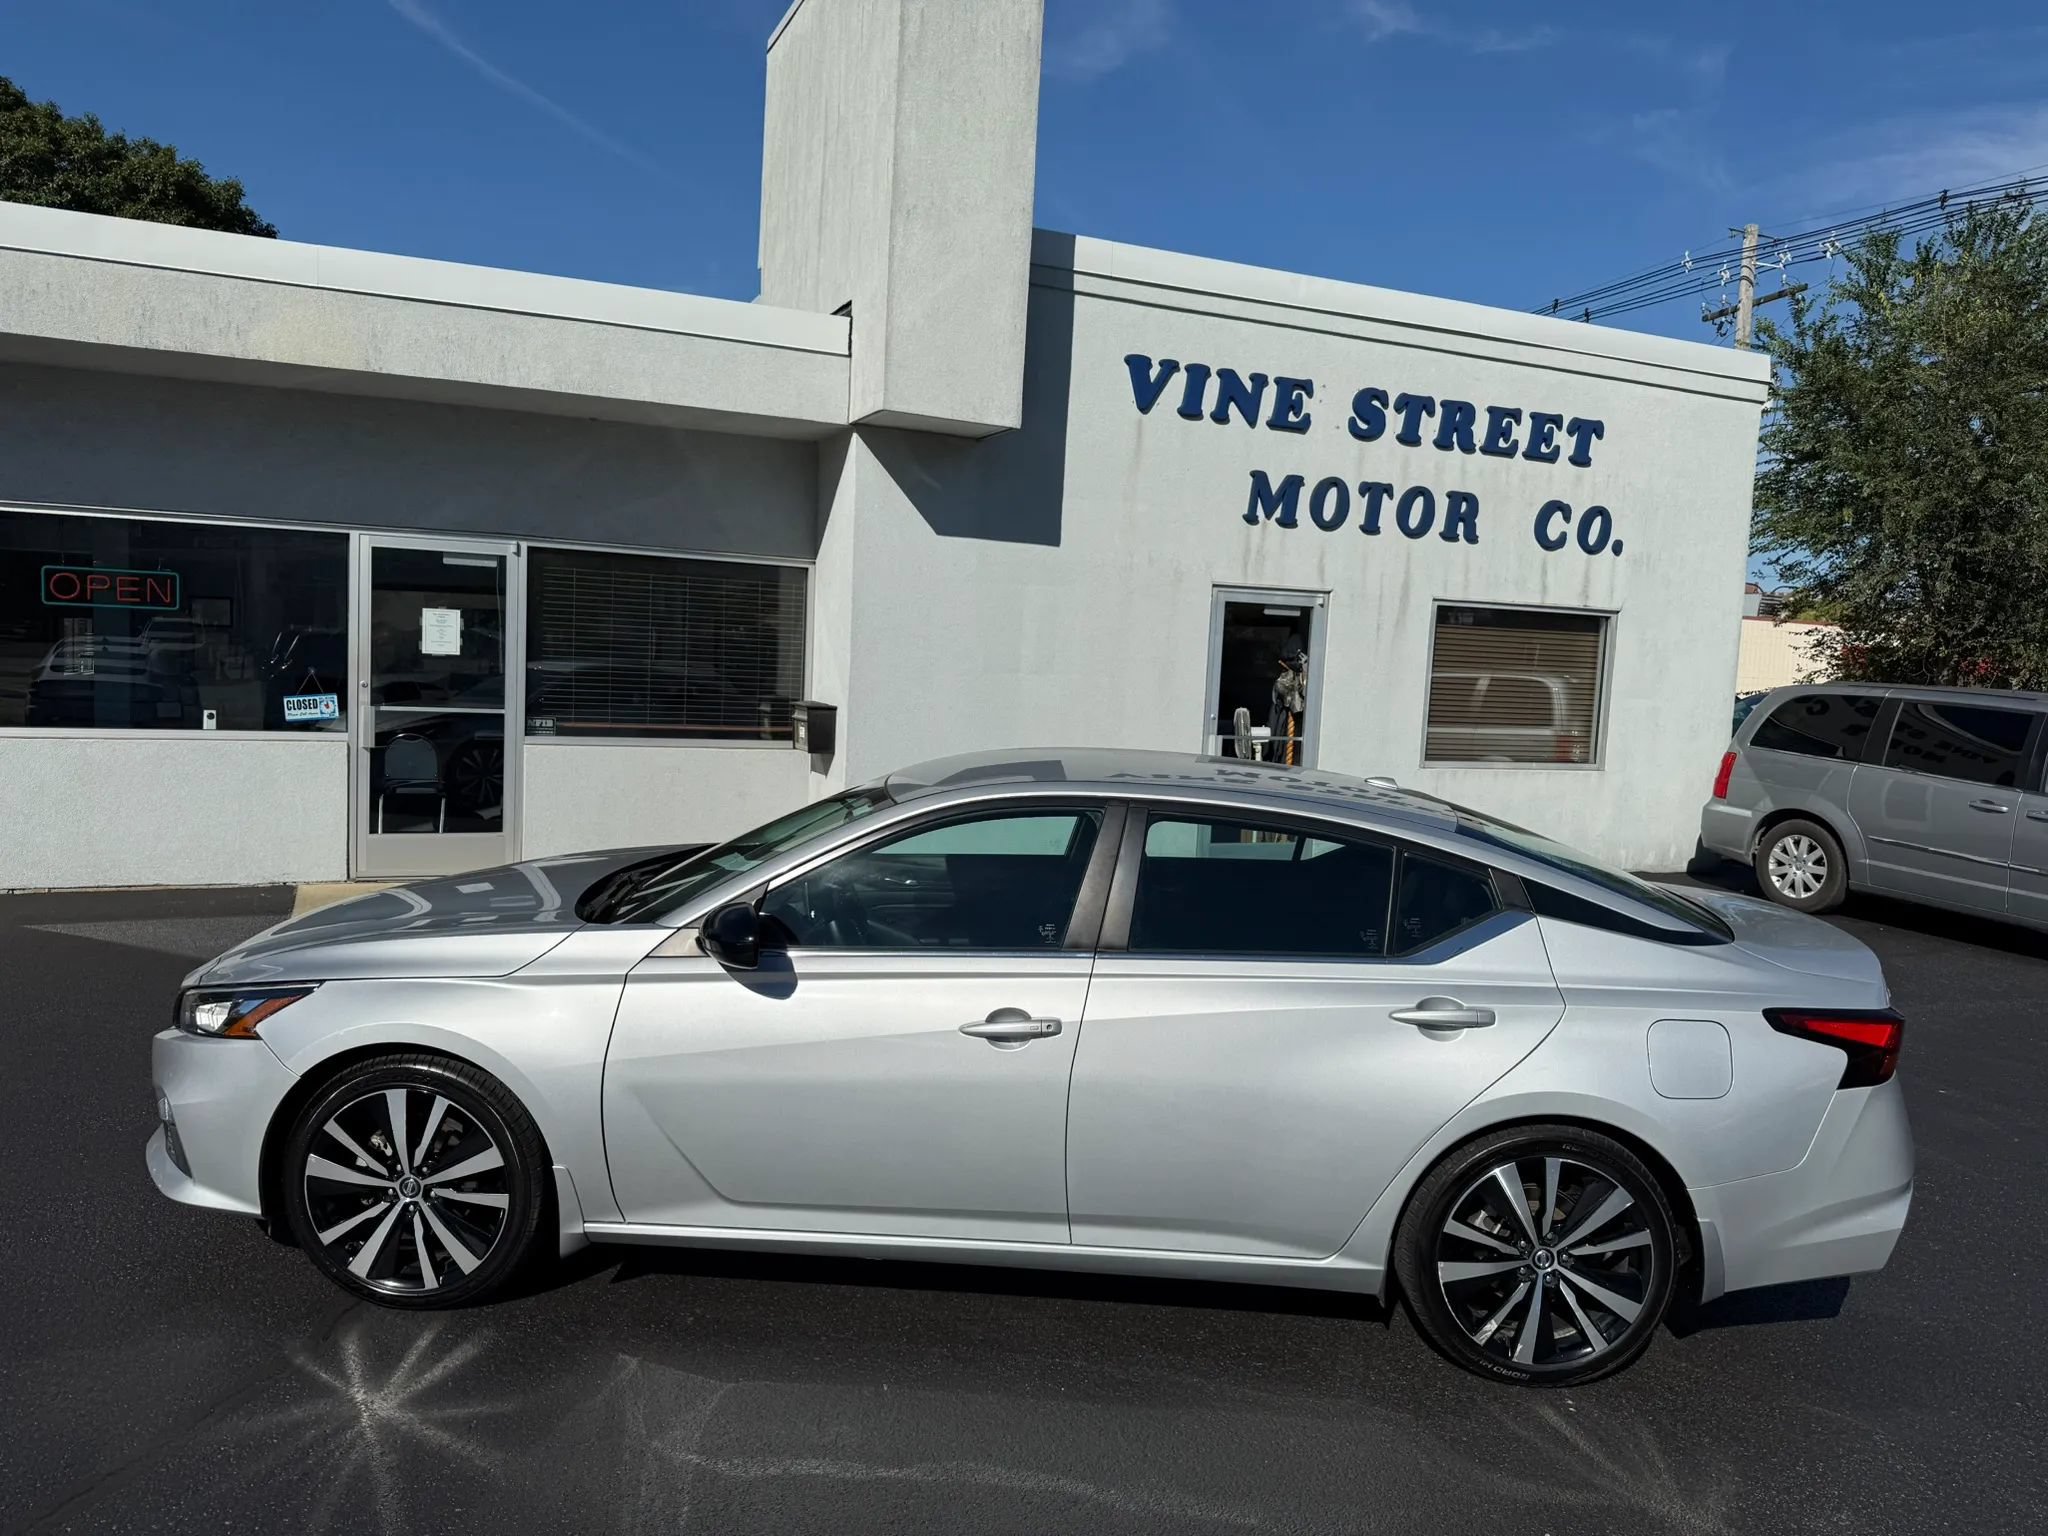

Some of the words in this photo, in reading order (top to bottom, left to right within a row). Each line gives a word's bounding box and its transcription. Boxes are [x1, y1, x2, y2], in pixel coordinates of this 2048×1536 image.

[1124, 354, 1314, 435] VINE
[1347, 387, 1605, 468] STREET
[1242, 470, 1479, 545] MOTOR
[1533, 500, 1624, 557] CO.
[50, 572, 171, 604] OPEN
[286, 698, 318, 711] CLOSED
